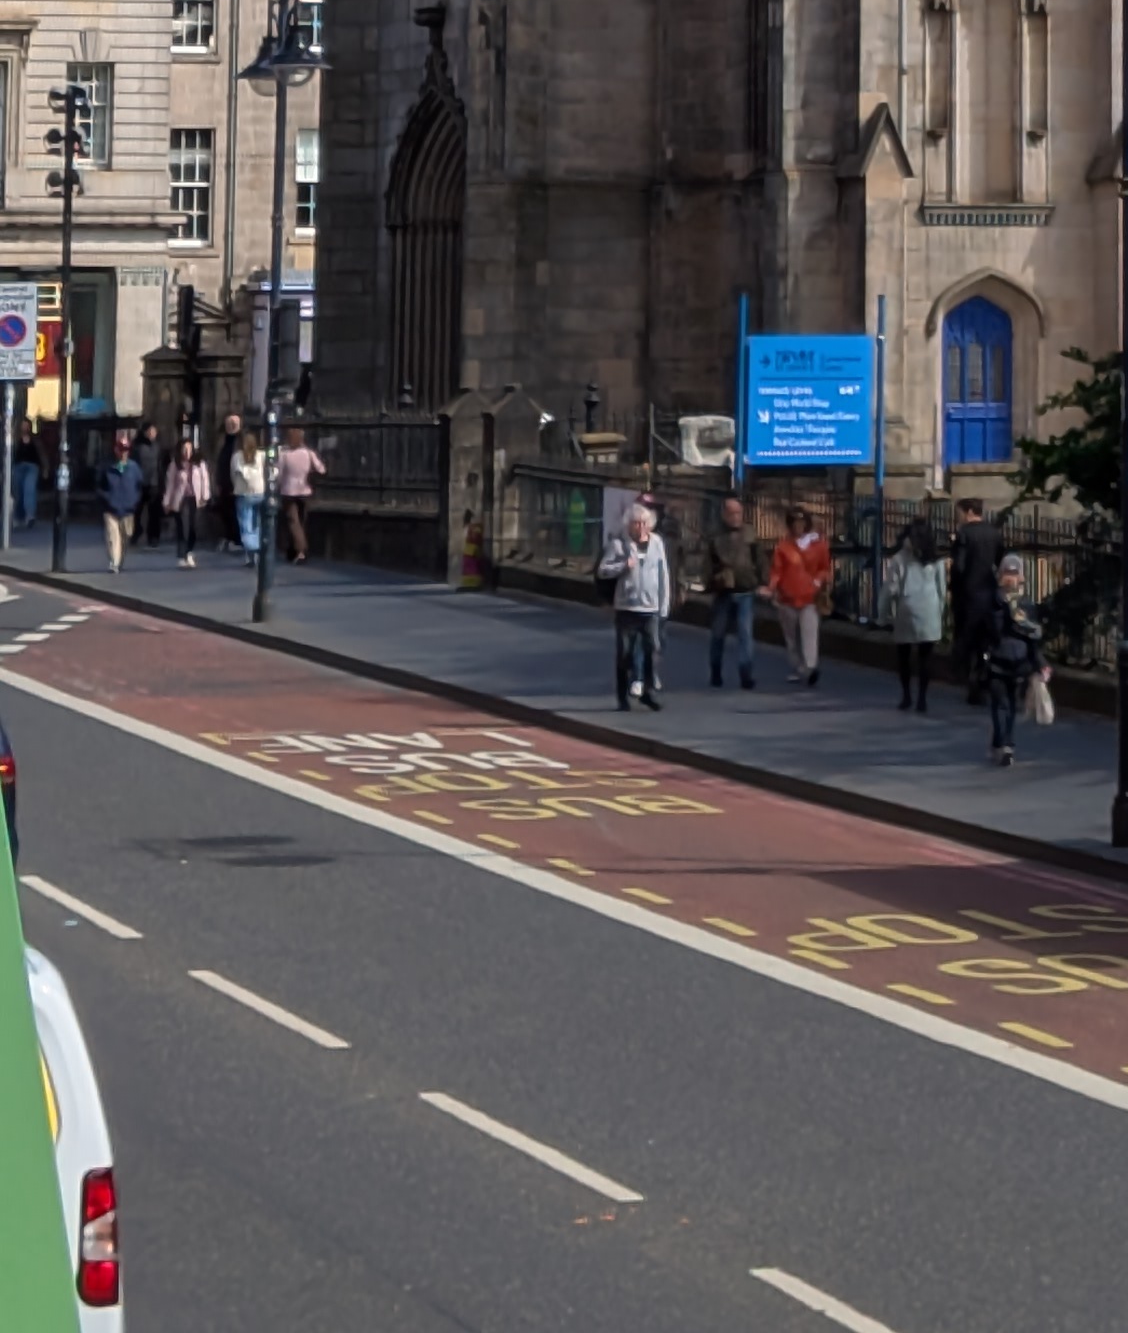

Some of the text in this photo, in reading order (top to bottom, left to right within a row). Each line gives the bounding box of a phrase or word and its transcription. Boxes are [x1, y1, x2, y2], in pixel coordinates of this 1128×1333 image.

[235, 729, 534, 753] LANE
[325, 749, 570, 775] BUS
[352, 769, 660, 802] STOP
[459, 793, 726, 821] BUS
